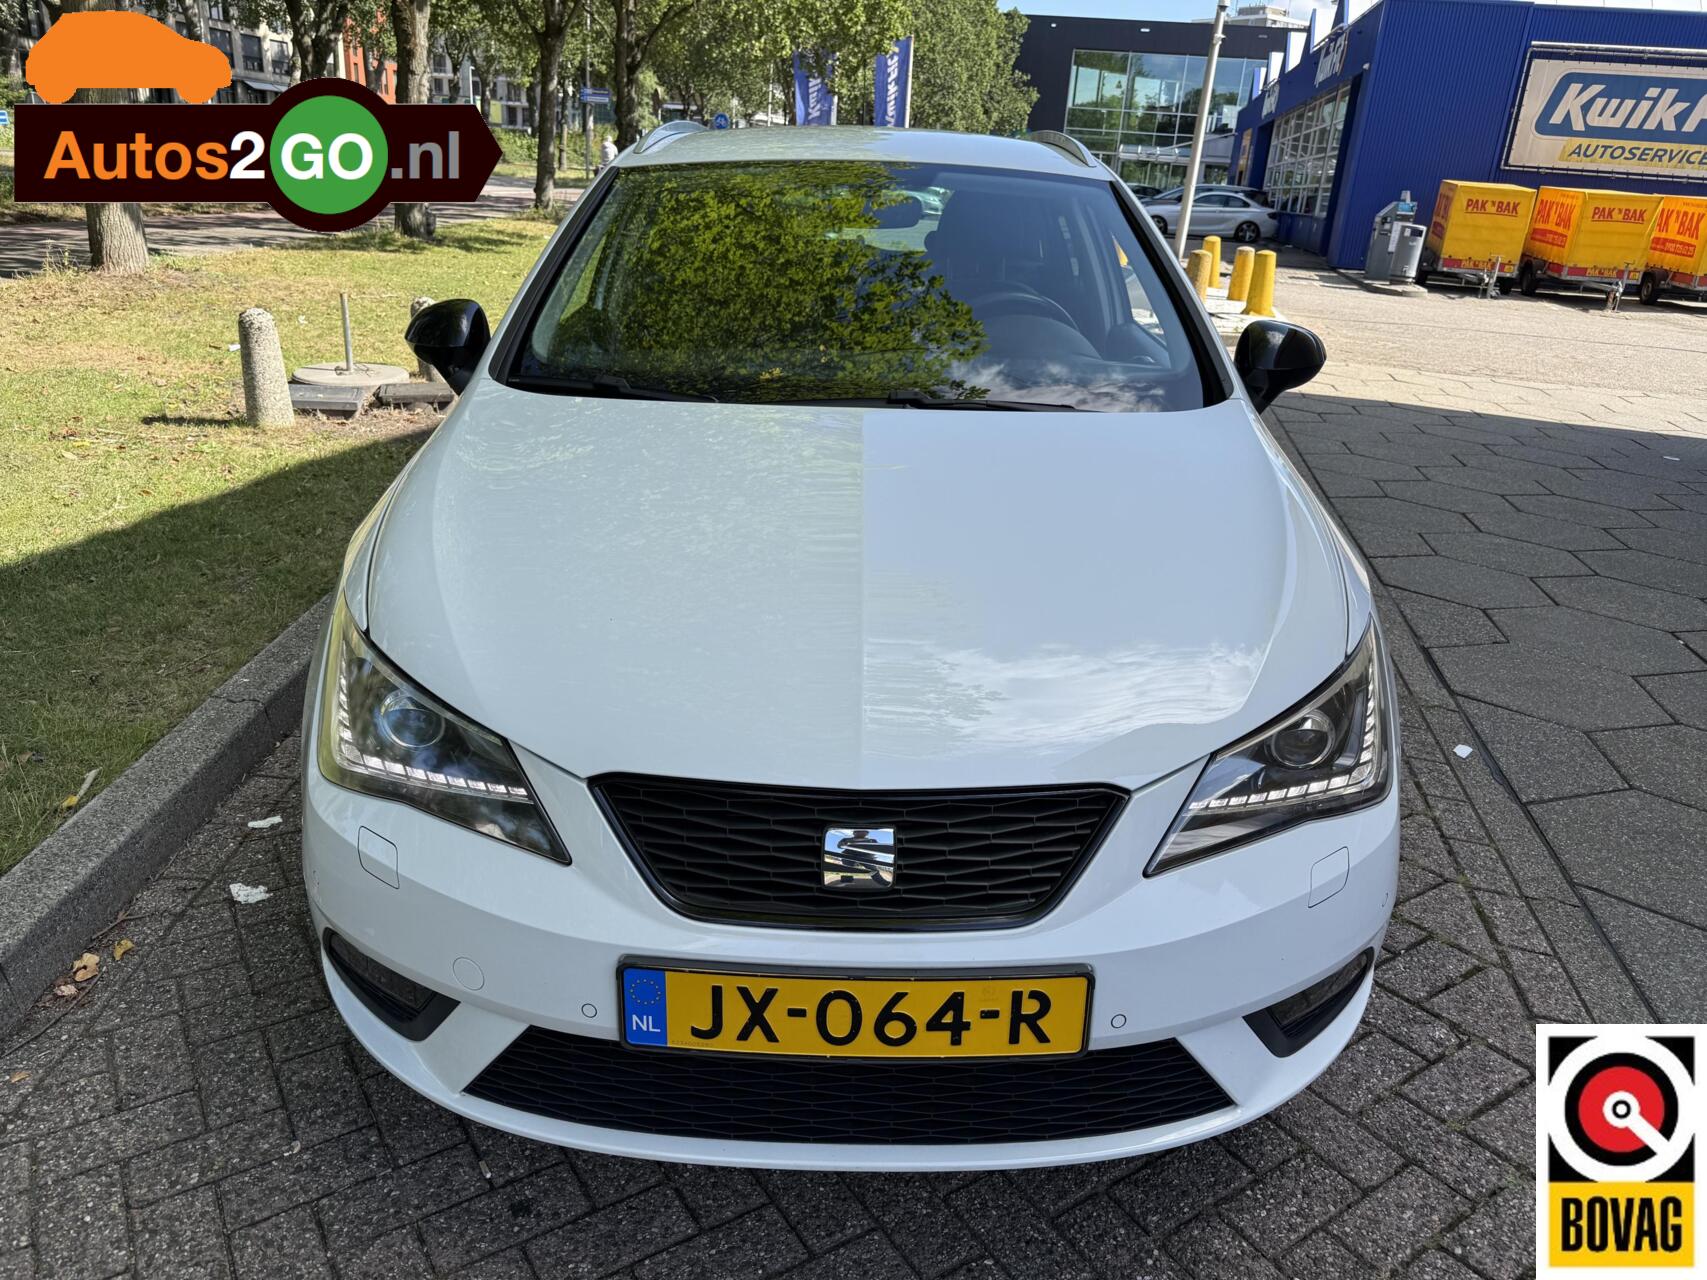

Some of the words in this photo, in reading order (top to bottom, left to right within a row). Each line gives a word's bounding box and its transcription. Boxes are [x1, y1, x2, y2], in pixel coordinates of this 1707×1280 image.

[1568, 143, 1707, 166] AUTOSERVICE
[1465, 198, 1489, 212] PAK
[1496, 201, 1520, 215] BAK
[1592, 206, 1616, 220] PAK
[1622, 208, 1647, 222] BAK
[1656, 207, 1675, 233] AK
[1677, 210, 1706, 241] BAK
[632, 1015, 661, 1033] NL
[690, 985, 1052, 1047] JX-064-R
